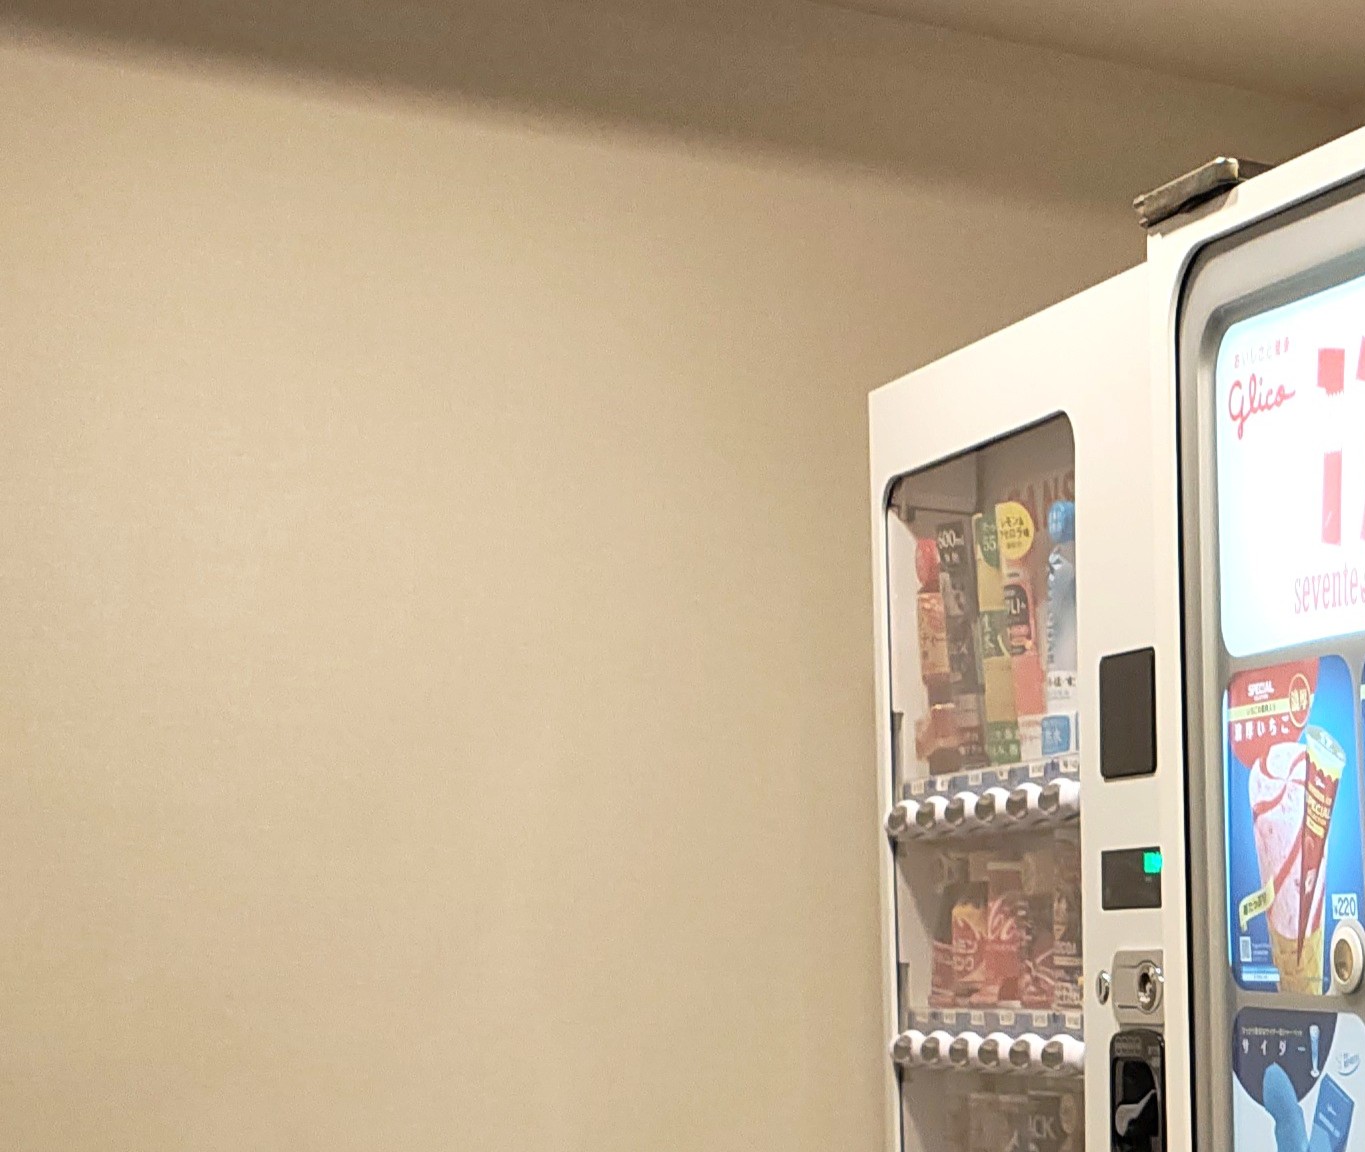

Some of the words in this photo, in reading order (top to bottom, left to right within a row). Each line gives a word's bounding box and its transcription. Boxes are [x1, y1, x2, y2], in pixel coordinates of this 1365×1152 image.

[1228, 373, 1296, 440] Glico
[1242, 1039, 1306, 1056] サイダー
